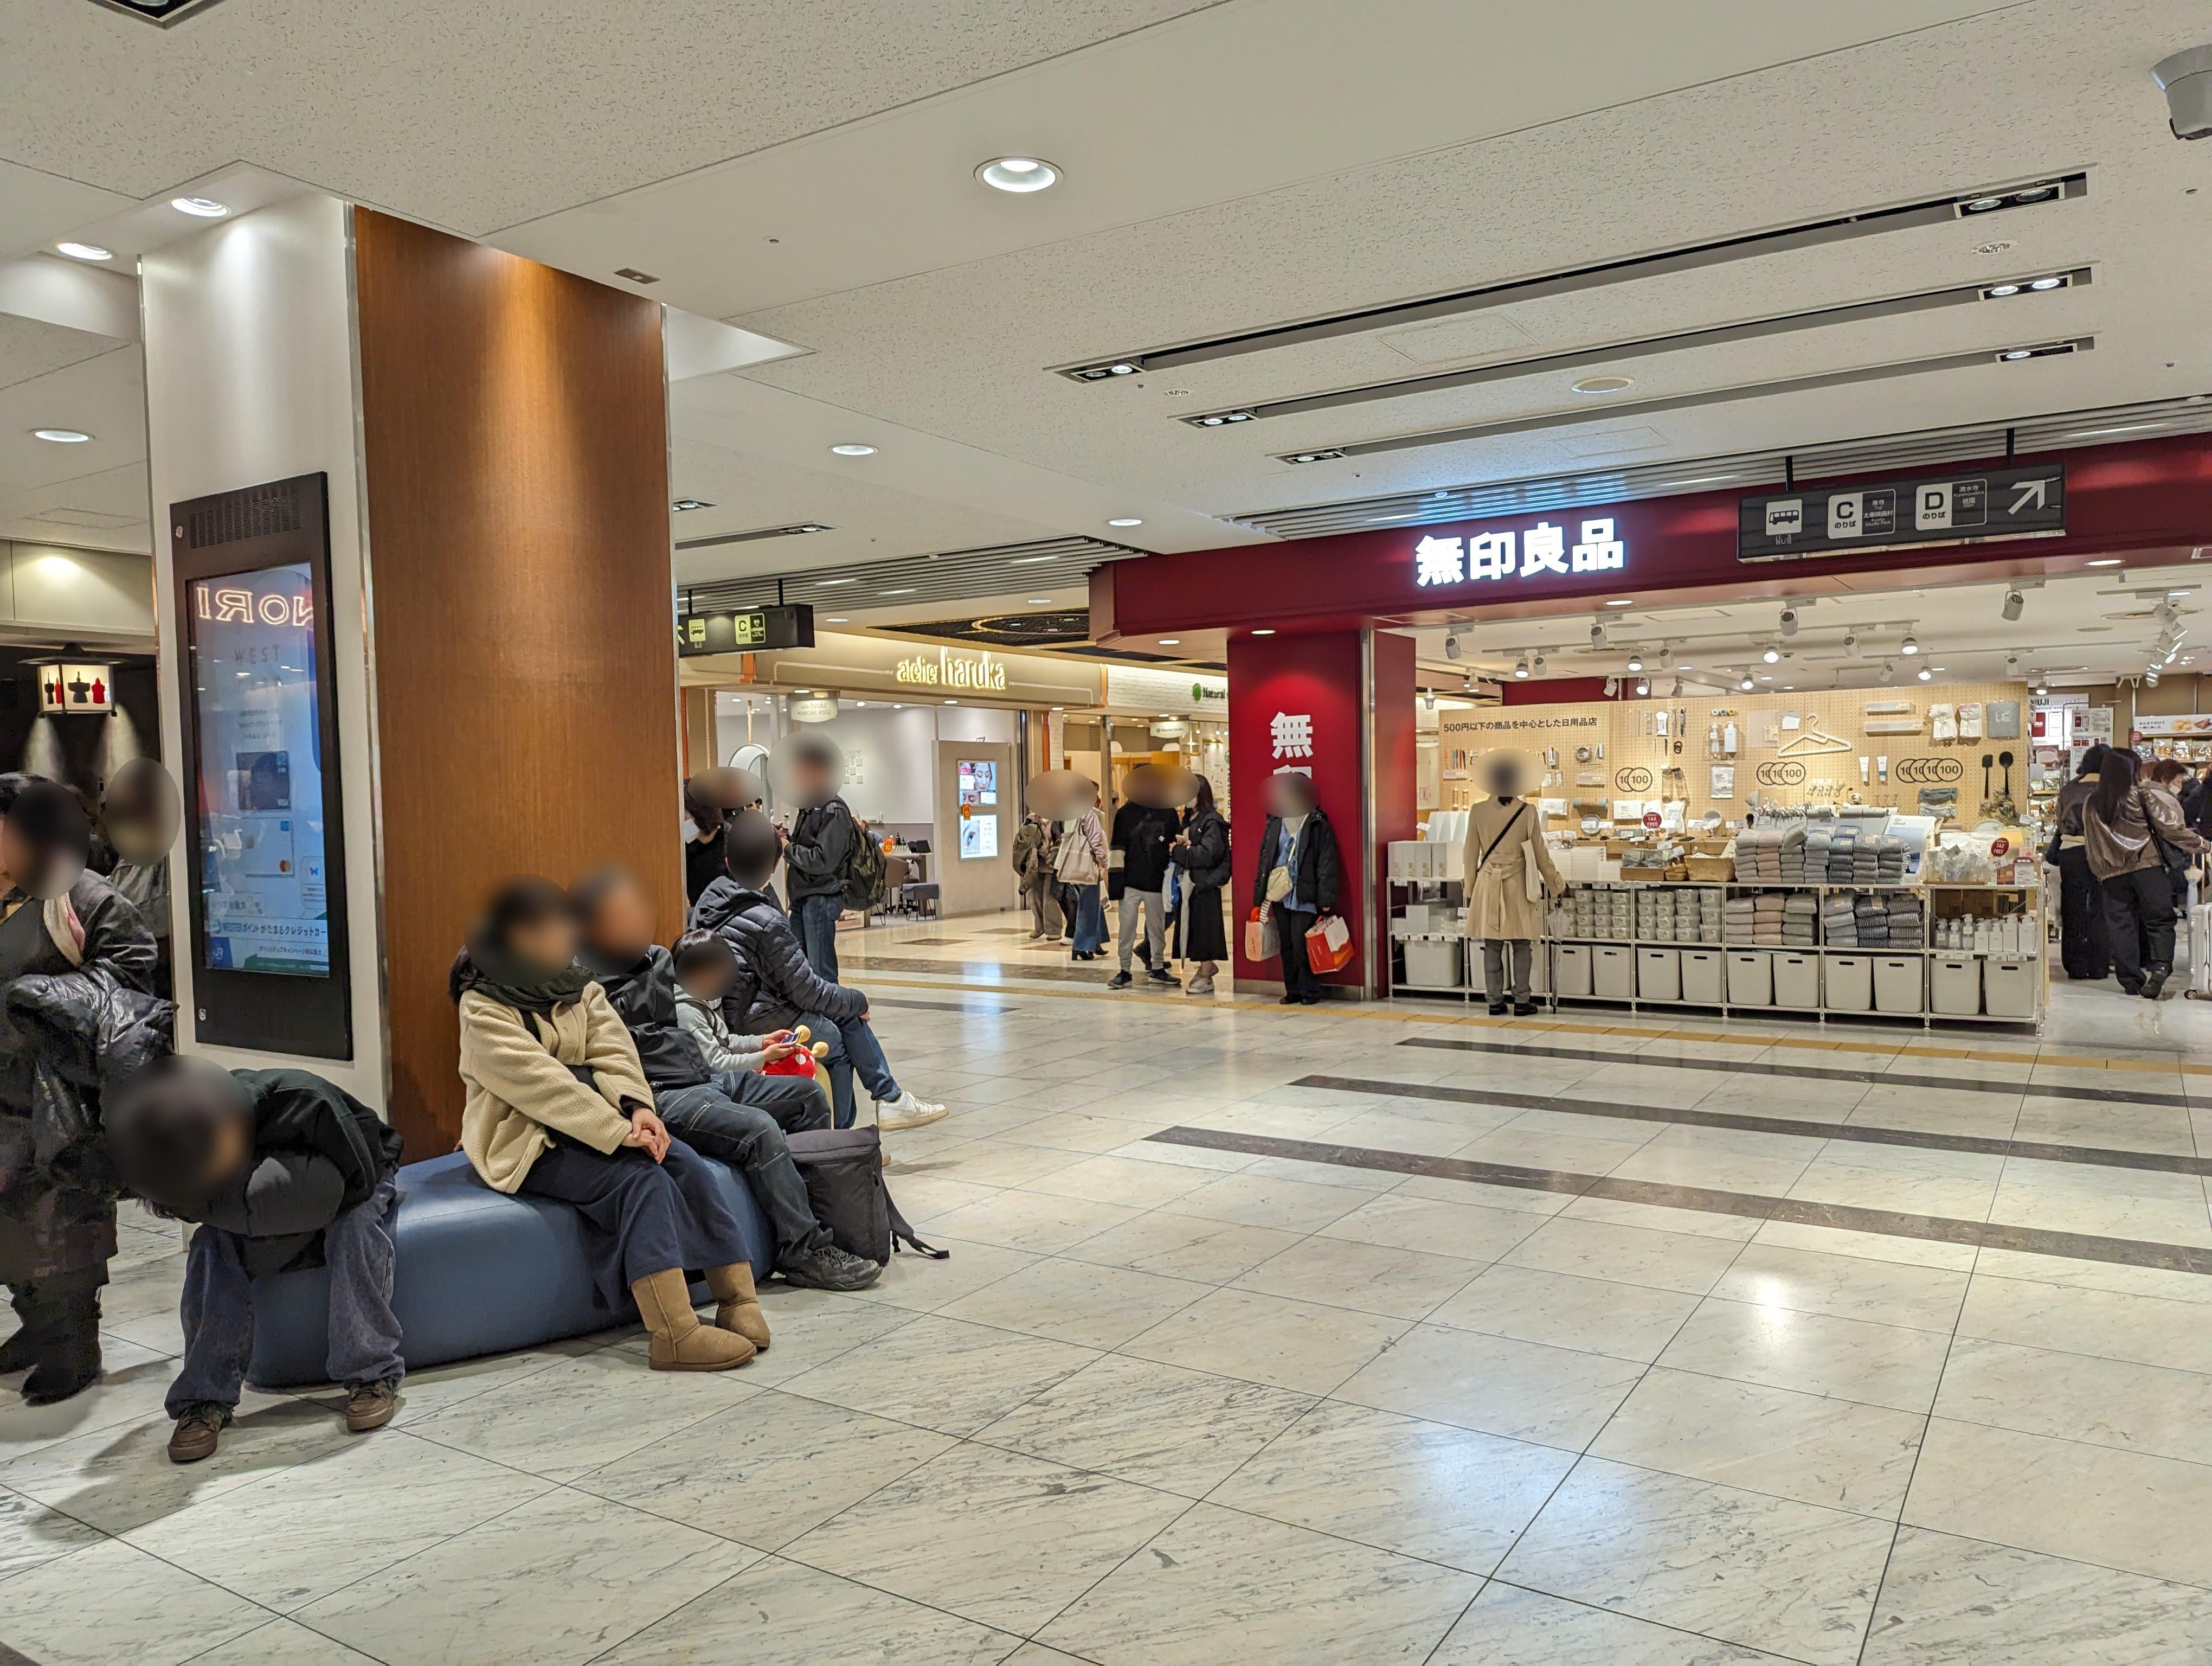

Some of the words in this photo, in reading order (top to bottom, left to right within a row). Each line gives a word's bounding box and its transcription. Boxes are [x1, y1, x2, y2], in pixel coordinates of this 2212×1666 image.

[1925, 492, 1944, 510] D
[1836, 501, 1854, 519] C
[1922, 511, 1946, 520] のりば
[1834, 520, 1856, 529] のりば
[1416, 517, 1624, 587] 無印良品
[738, 620, 747, 631] C
[897, 656, 938, 684] atelier
[940, 646, 1006, 690] haruka
[1203, 687, 1225, 699] Natural
[1443, 717, 1597, 732] 500円以下の商品を中心とした日用品店
[1784, 770, 1801, 778] 100
[1940, 766, 1959, 774] 100
[1631, 776, 1648, 784] 100
